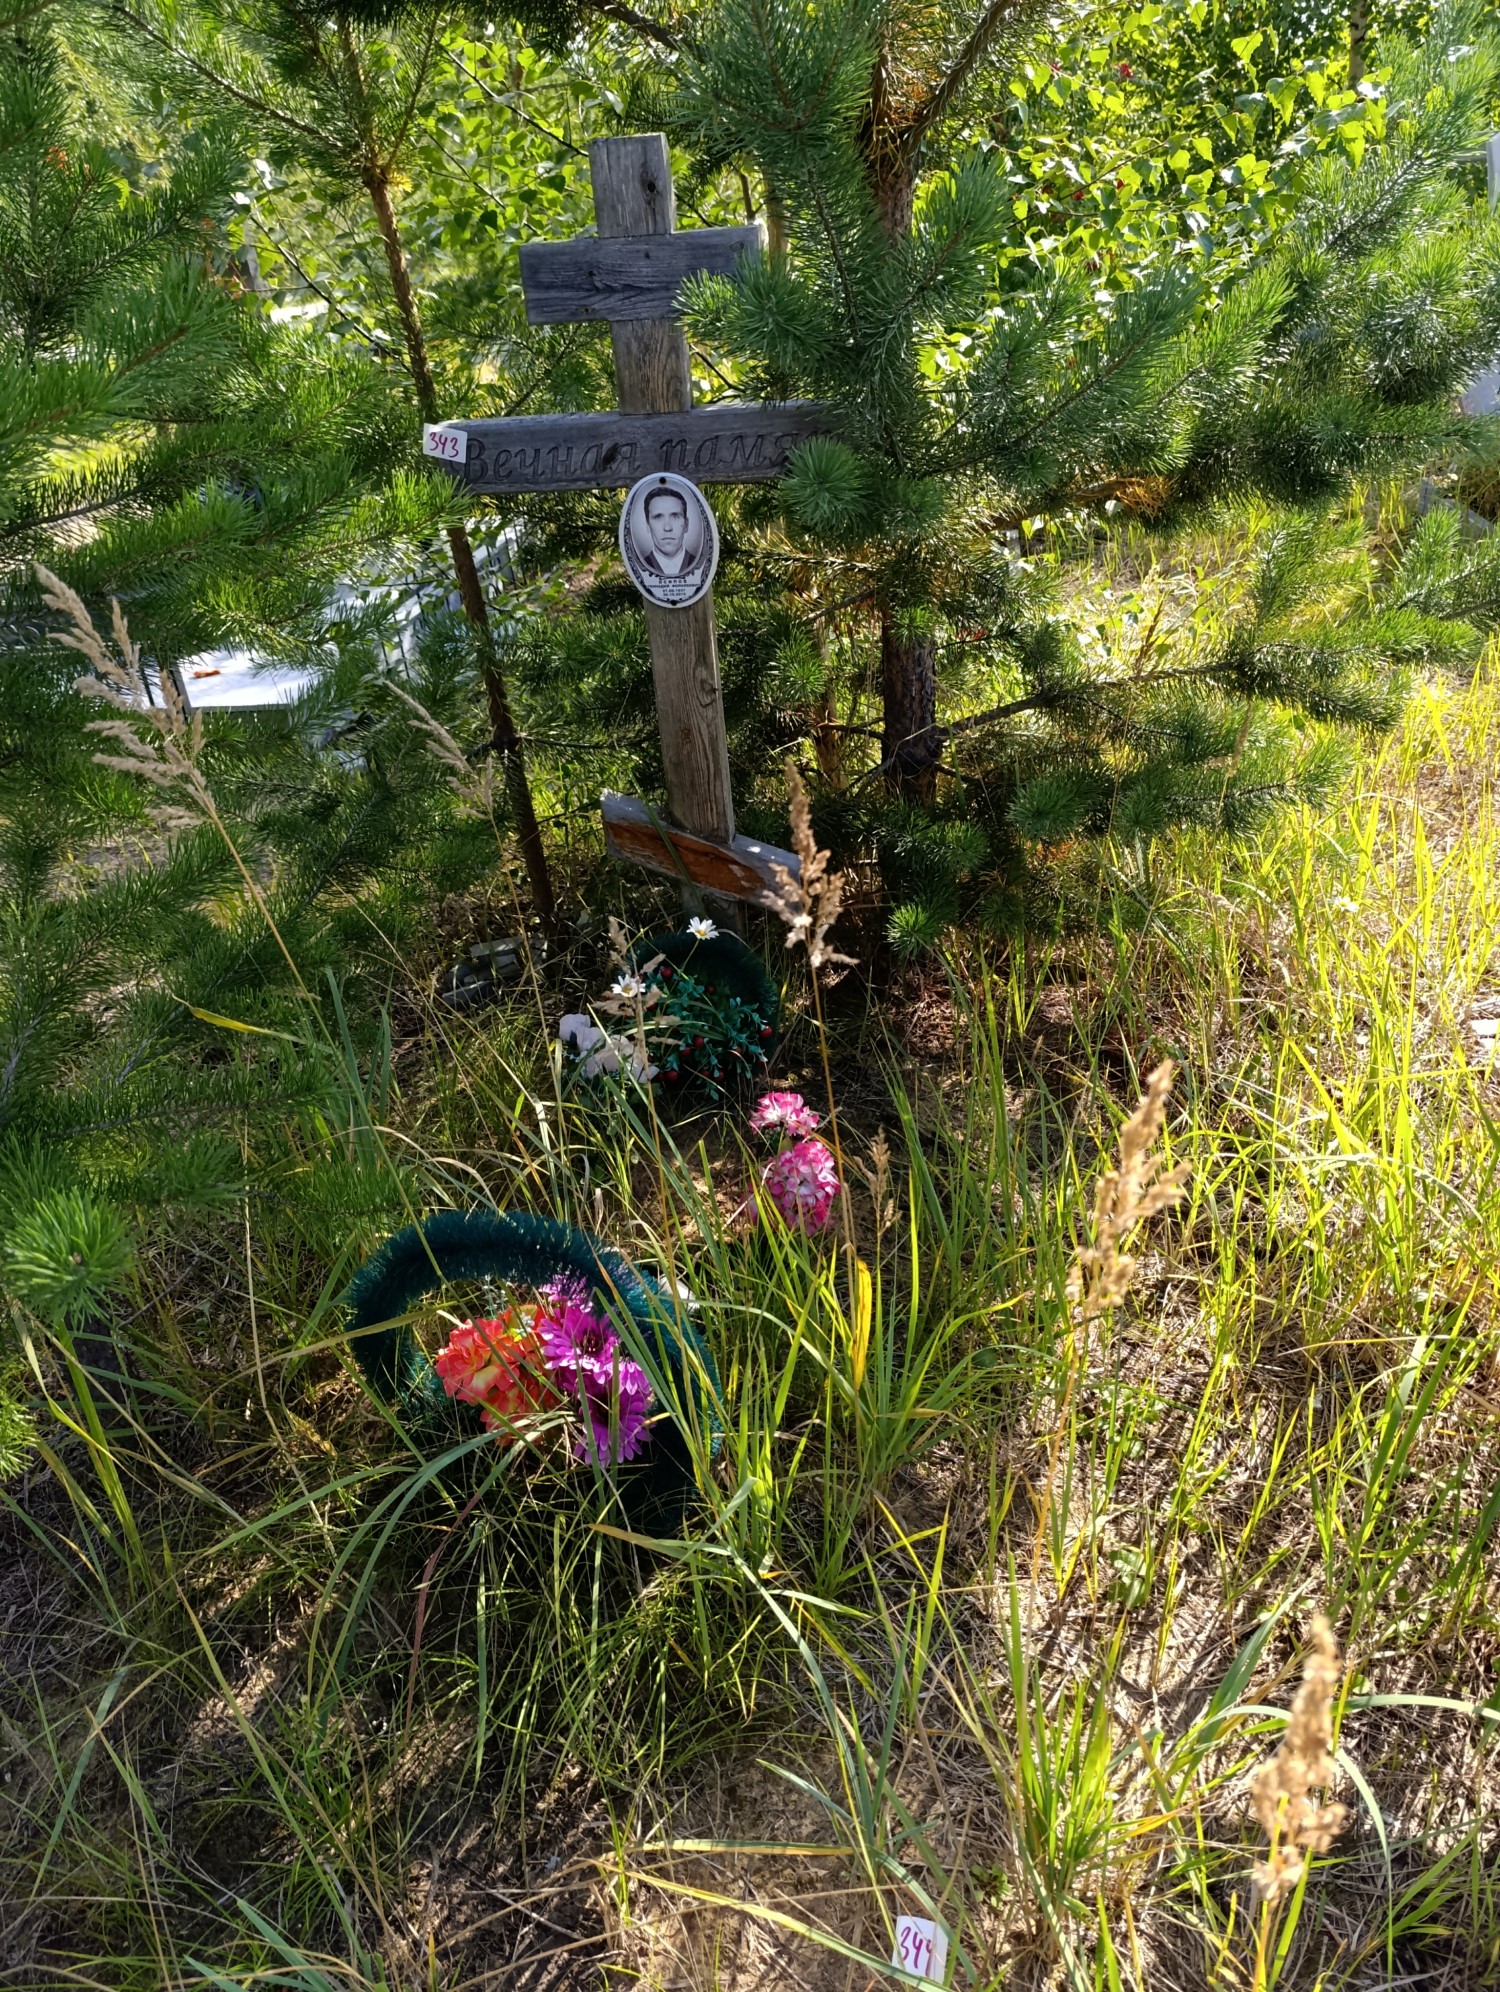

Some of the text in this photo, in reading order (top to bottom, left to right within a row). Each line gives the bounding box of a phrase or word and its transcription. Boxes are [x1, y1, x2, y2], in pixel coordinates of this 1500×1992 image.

[429, 431, 460, 459] 343
[463, 428, 834, 482] Вечная памя
[900, 1925, 933, 1977] 344
